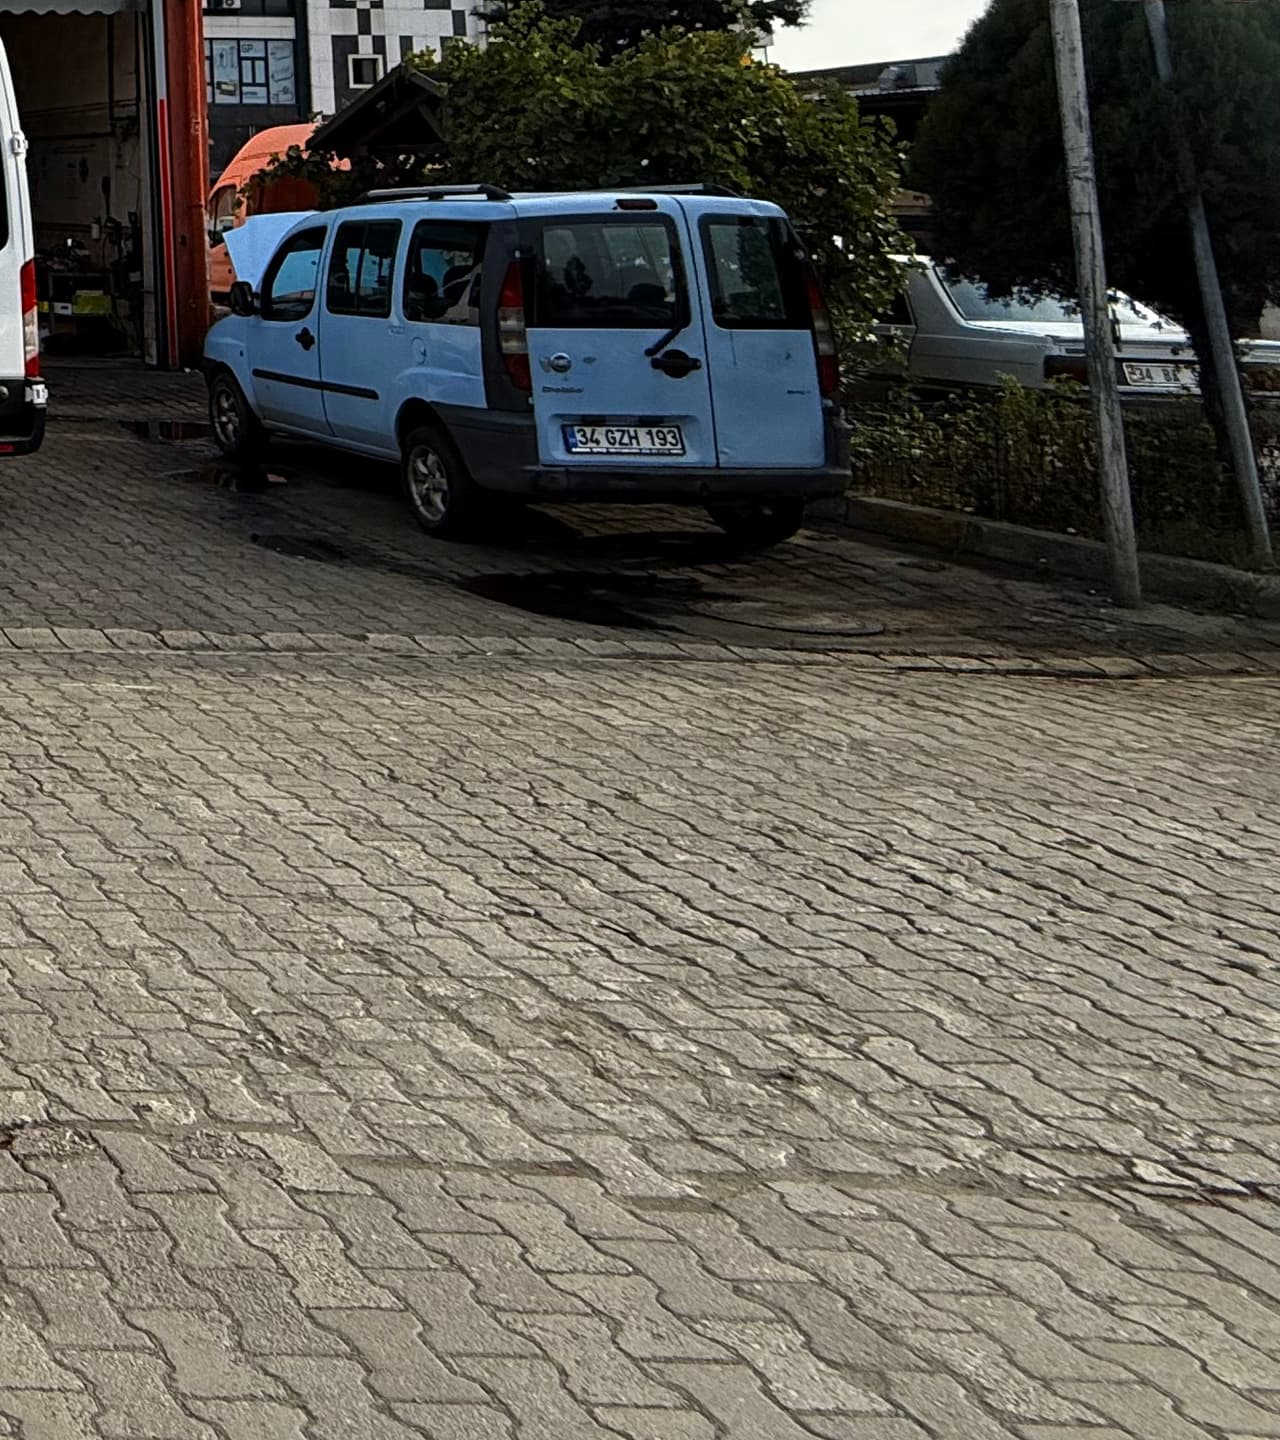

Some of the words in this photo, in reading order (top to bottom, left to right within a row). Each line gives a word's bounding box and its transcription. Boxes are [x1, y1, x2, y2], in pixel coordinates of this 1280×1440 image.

[577, 428, 600, 446] 34
[605, 429, 640, 447] GZH
[646, 430, 679, 447] 193
